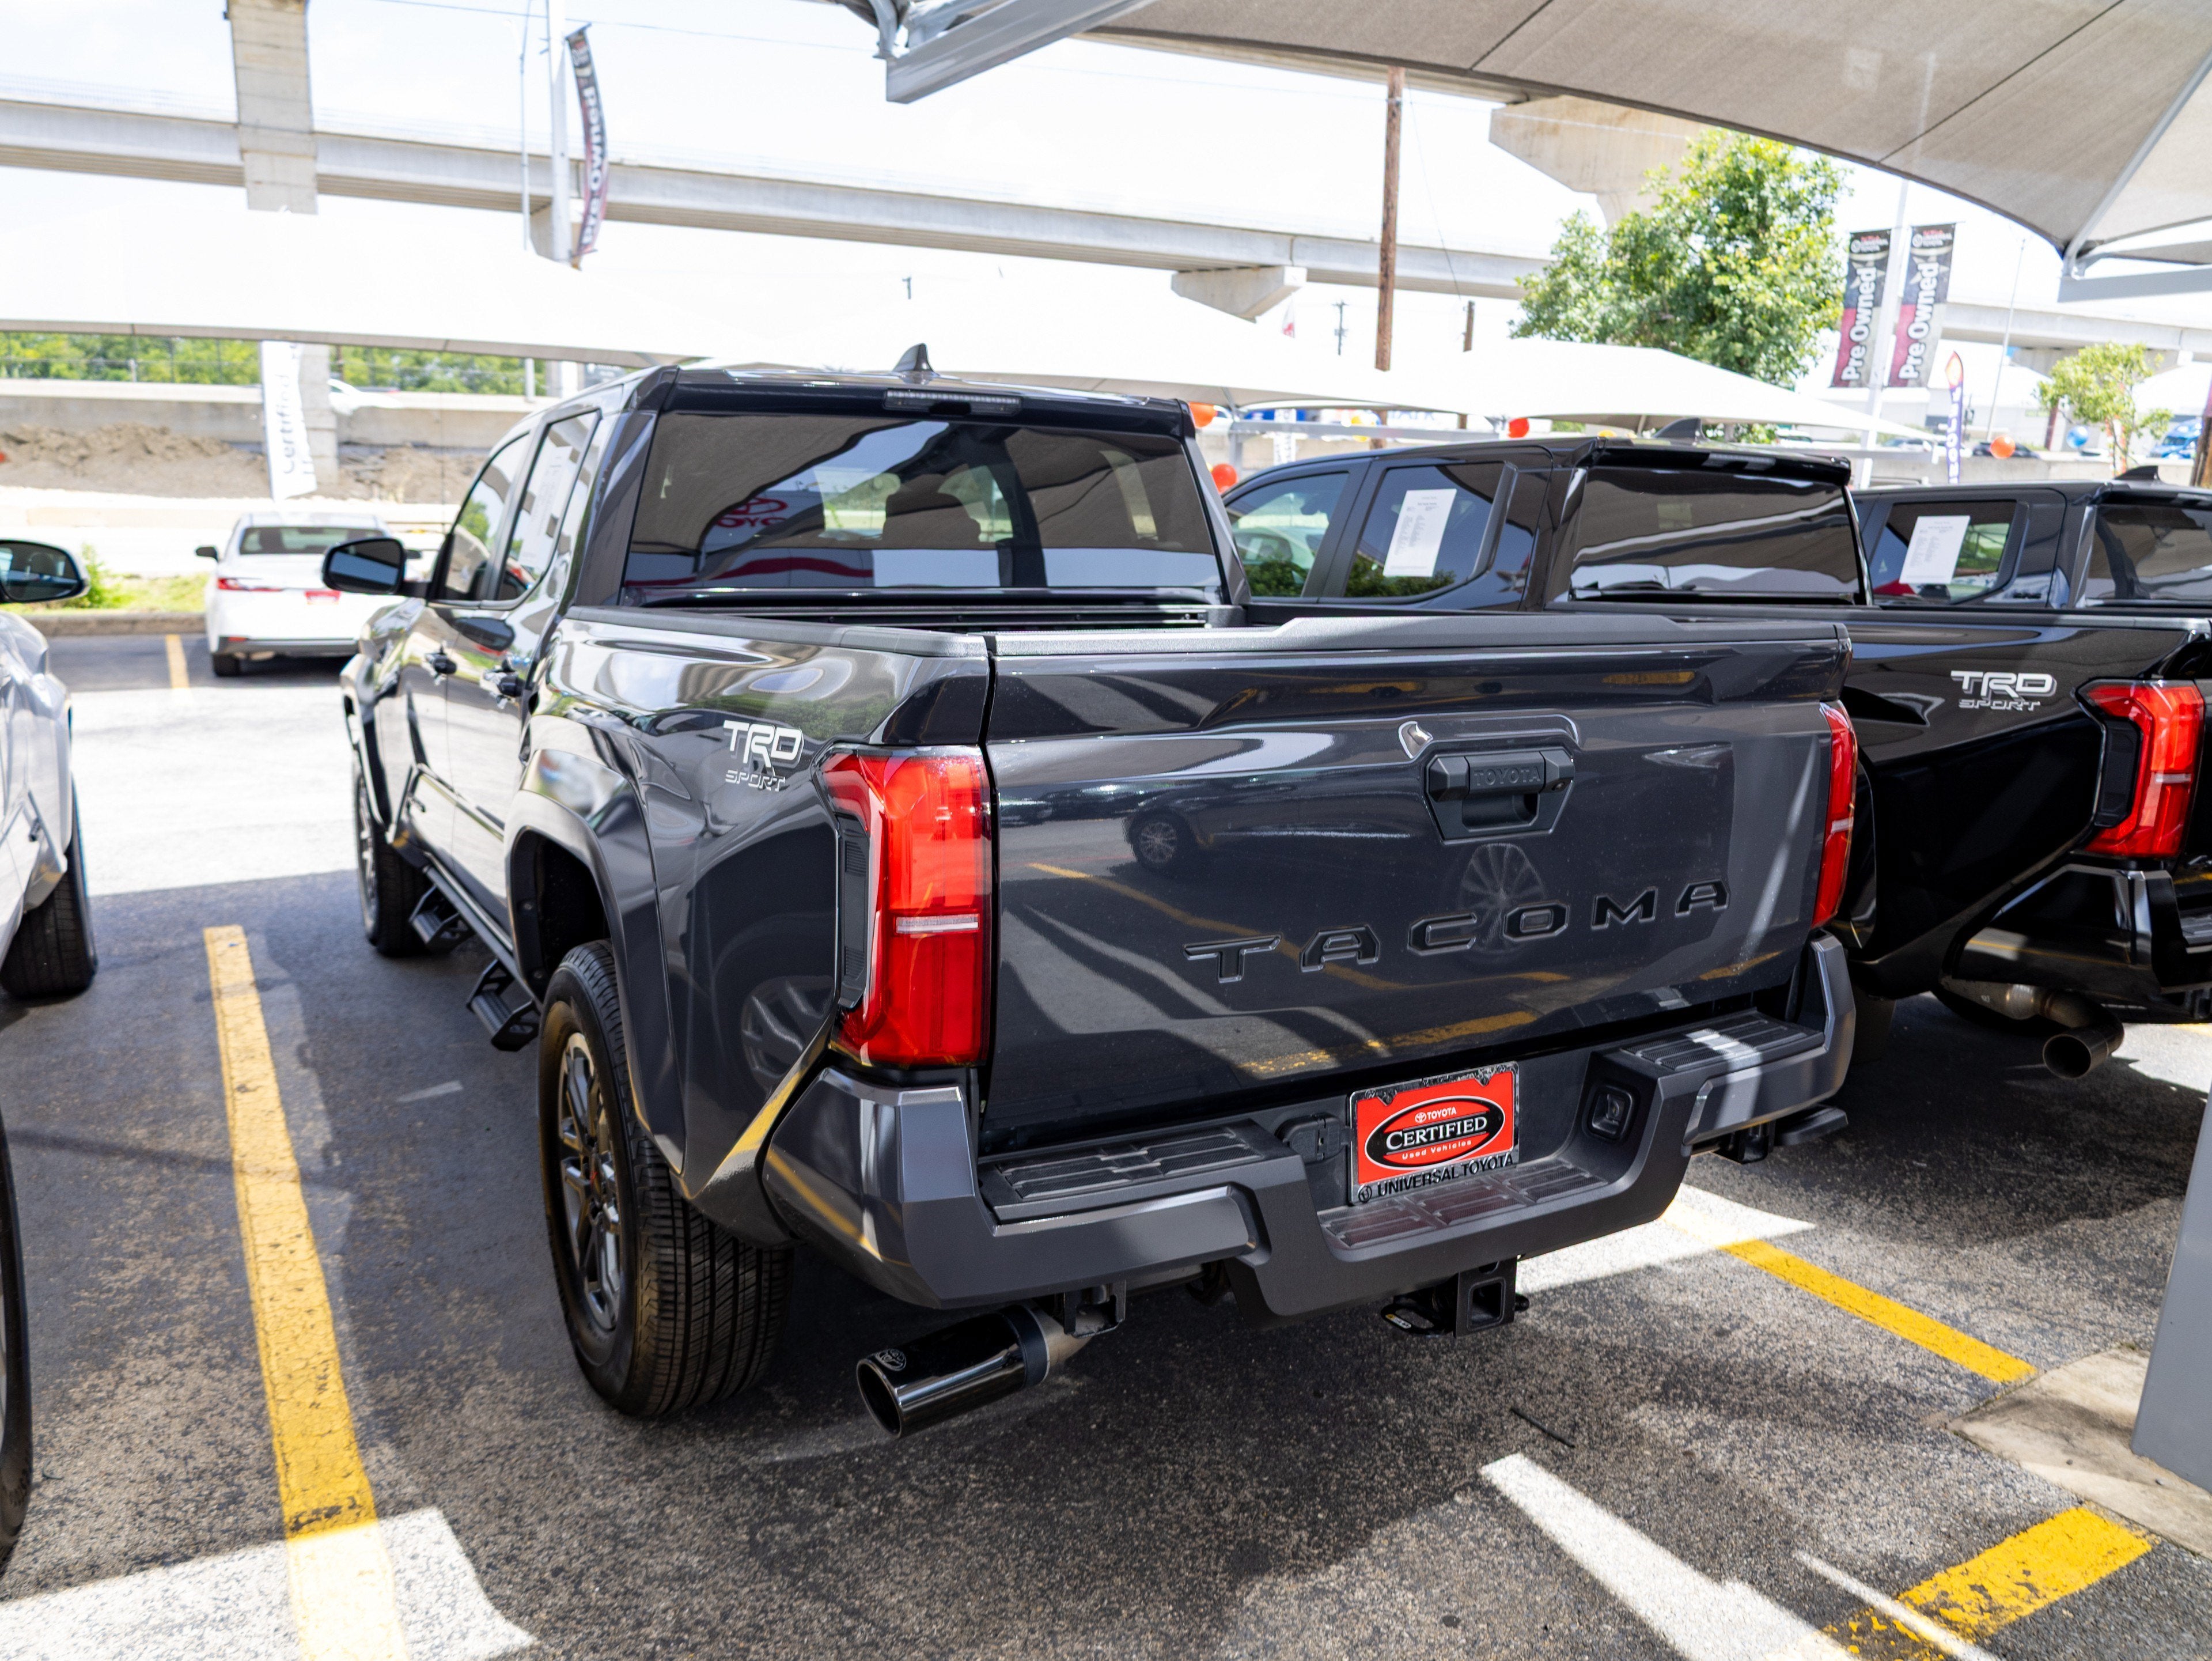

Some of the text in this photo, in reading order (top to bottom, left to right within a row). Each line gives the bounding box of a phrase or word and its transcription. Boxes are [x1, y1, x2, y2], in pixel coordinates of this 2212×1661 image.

[1849, 266, 1877, 342] Owned
[1908, 262, 1939, 339] Owned
[1842, 343, 1866, 381] Pre
[1899, 342, 1925, 379] Pre
[274, 374, 296, 474] Certified
[1950, 670, 2057, 700] TRD
[1959, 699, 2041, 712] SPORT
[723, 720, 804, 771] TRD
[725, 769, 786, 793] SPORT
[1473, 766, 1541, 786] TOYOTA
[1182, 878, 1732, 985] TACOMA
[1426, 1107, 1457, 1119] TOYOTA
[1385, 1116, 1488, 1151] CERTIFIED
[1402, 1140, 1472, 1160] Used Vehicles
[1377, 1165, 1460, 1197] UNIVERSAL
[1460, 1154, 1514, 1176] TOYOTA
